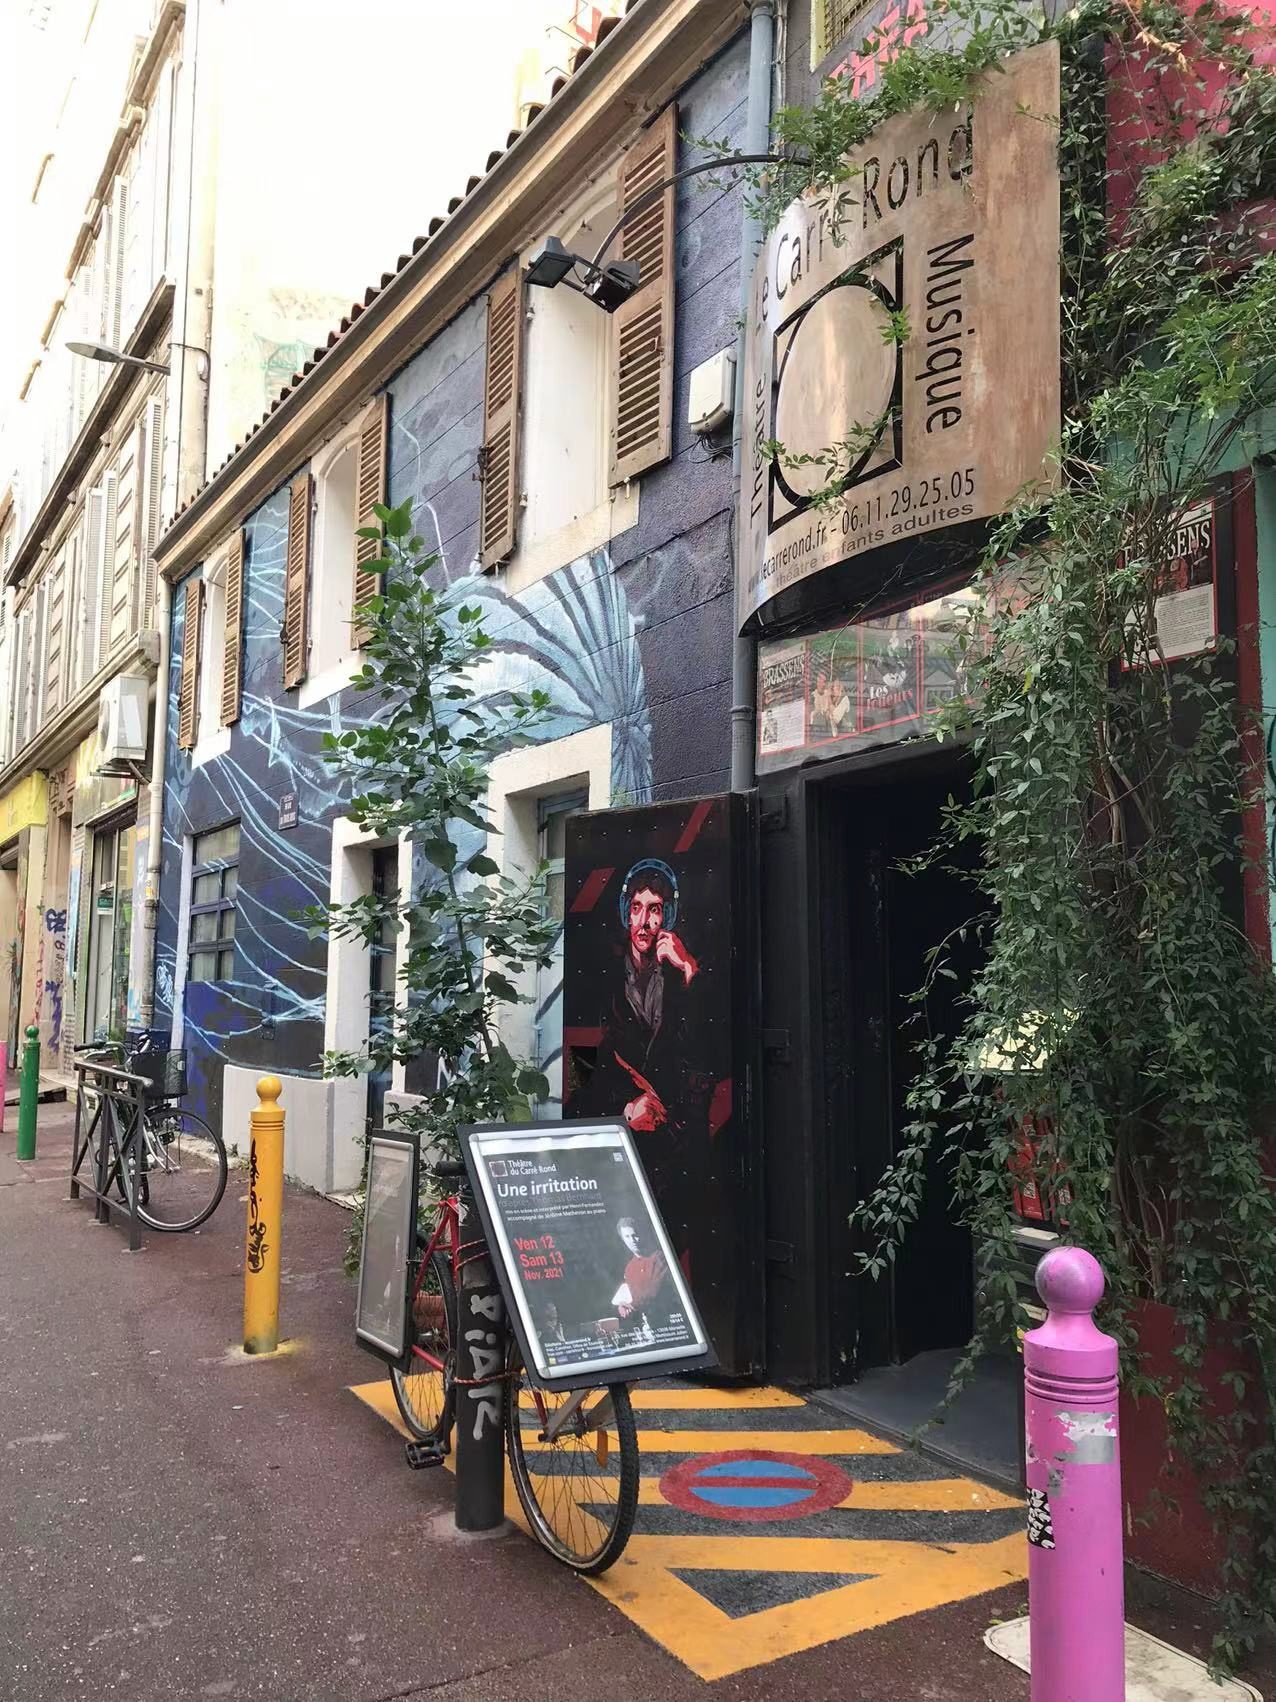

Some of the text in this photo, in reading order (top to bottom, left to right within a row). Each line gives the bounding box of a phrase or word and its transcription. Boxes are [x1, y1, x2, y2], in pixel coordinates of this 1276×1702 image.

[776, 207, 840, 301] Carr
[915, 233, 975, 434] Musique
[842, 468, 975, 534] 06.11.29.25.05
[891, 502, 974, 535] adultes
[508, 1160, 532, 1168] Théâtre
[510, 1164, 557, 1176] du Carré Rond
[497, 1176, 598, 1197] Une irritation
[513, 1235, 555, 1250] Ven 12
[520, 1251, 564, 1267] Sam 13
[523, 1268, 564, 1280] Nov. 2021
